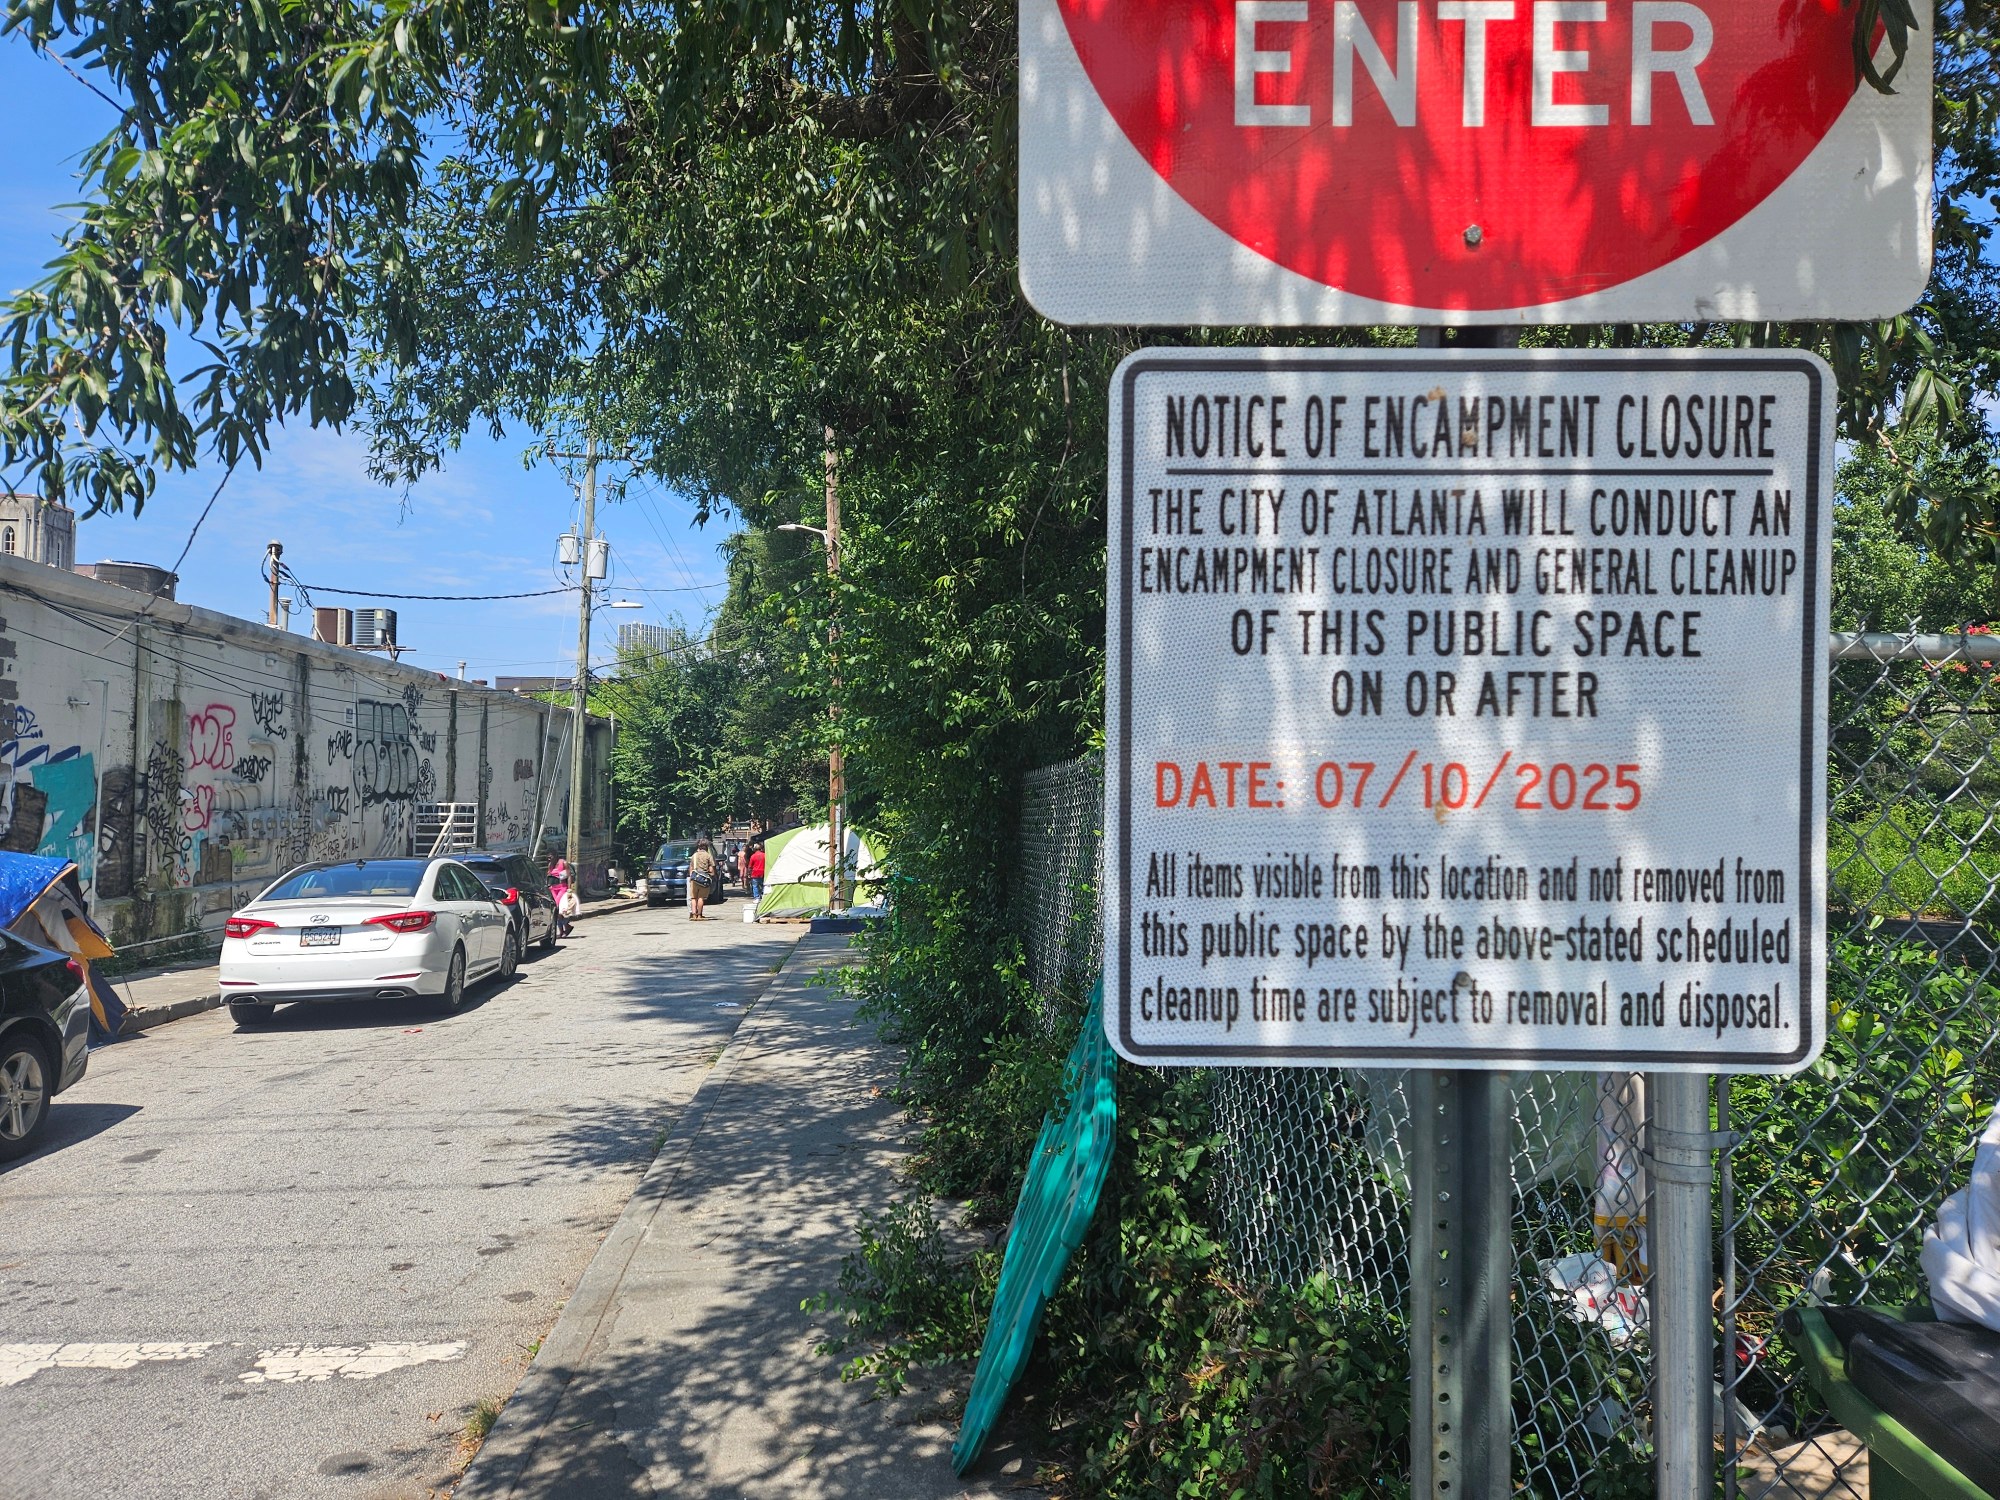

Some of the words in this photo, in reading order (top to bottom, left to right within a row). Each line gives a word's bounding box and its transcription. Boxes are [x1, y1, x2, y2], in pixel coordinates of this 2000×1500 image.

[1234, 0, 1716, 128] ENTER
[1166, 394, 1287, 459] NOTICE
[1305, 394, 1344, 459] OF
[1364, 394, 1601, 459] ENCAMPMENT
[1616, 394, 1776, 459] CLOSURE
[1149, 489, 1204, 535] THE
[1219, 489, 1286, 535] CITY
[1301, 489, 1339, 535] OF
[1352, 489, 1486, 535] ATLANTA
[1501, 489, 1574, 535] WILL
[1590, 489, 1734, 535] CONDUCT
[1750, 489, 1791, 535] AN
[1140, 548, 1320, 594] ENCAMPMENT
[1332, 548, 1452, 594] CLOSURE
[1467, 548, 1520, 594] AND
[1535, 549, 1658, 595] GENERAL
[1671, 549, 1797, 596] CLEANUP
[1231, 610, 1277, 655] OF
[1298, 610, 1386, 656] THIS
[1407, 611, 1552, 656] PUBLIC
[1573, 611, 1701, 657] SPACE
[1331, 671, 1382, 716] ON
[1405, 671, 1455, 716] OR
[1476, 671, 1598, 717] AFTER
[1156, 762, 1285, 808] DATE:
[1314, 750, 1642, 811] 07/10/2025
[1145, 852, 1177, 898] All
[1187, 852, 1243, 898] items
[1251, 853, 1323, 899] visible
[1332, 854, 1380, 901] from
[1391, 855, 1430, 901] this
[1441, 855, 1528, 901] location
[1539, 856, 1578, 902] and
[1589, 858, 1624, 902] not
[1633, 857, 1725, 904] removed
[1735, 858, 1785, 904] from
[1140, 911, 1188, 957] this
[1201, 912, 1280, 967] public
[1294, 923, 1369, 968] space
[1381, 914, 1412, 970] by
[1422, 914, 1465, 959] the
[1476, 916, 1643, 962] above-stated
[1655, 917, 1791, 964] scheduled
[1140, 978, 1239, 1031] cleanup
[1251, 979, 1305, 1022] time
[1317, 987, 1356, 1023] are
[1368, 978, 1461, 1038] subject
[1469, 980, 1494, 1024] to
[1507, 982, 1608, 1026] removal
[1620, 982, 1664, 1028] and
[1678, 983, 1790, 1038] disposal.
